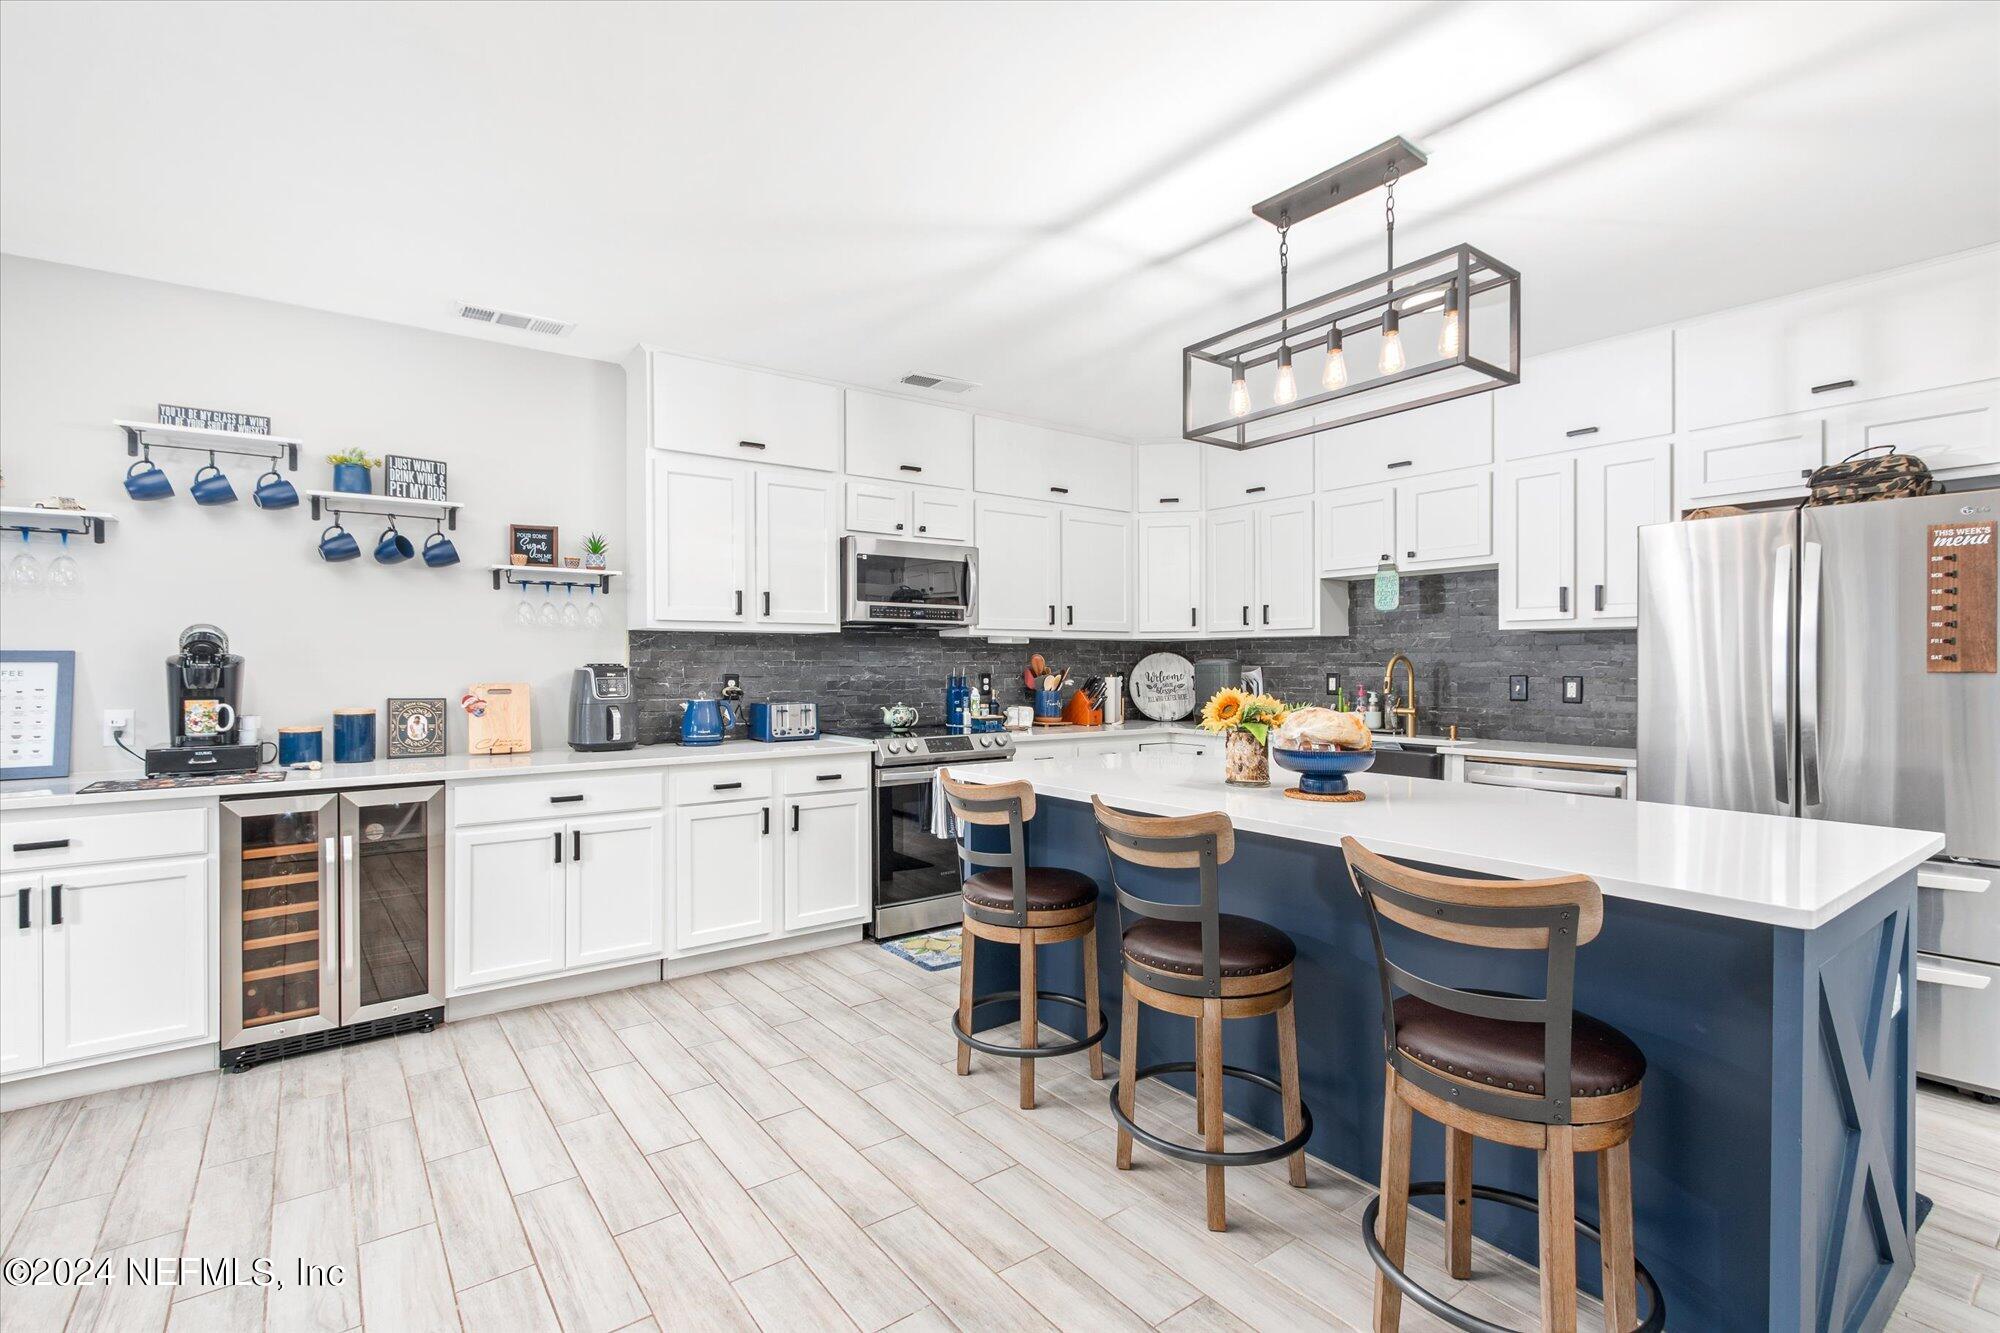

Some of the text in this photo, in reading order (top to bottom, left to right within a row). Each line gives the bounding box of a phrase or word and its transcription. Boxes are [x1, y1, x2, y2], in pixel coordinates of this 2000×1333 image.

[160, 405, 269, 430] YOU'LL BE MY GLASS OF WINE
[393, 456, 412, 471] JUST
[413, 460, 435, 474] WANT
[435, 463, 446, 475] TO
[390, 468, 447, 487] DRINK WINE &
[390, 481, 447, 501] PET MY DOG
[1933, 526, 1991, 537] THIS WEEK'S
[1933, 534, 1991, 547] menu
[519, 537, 548, 558] Sugar
[1145, 671, 1186, 683] Welcome
